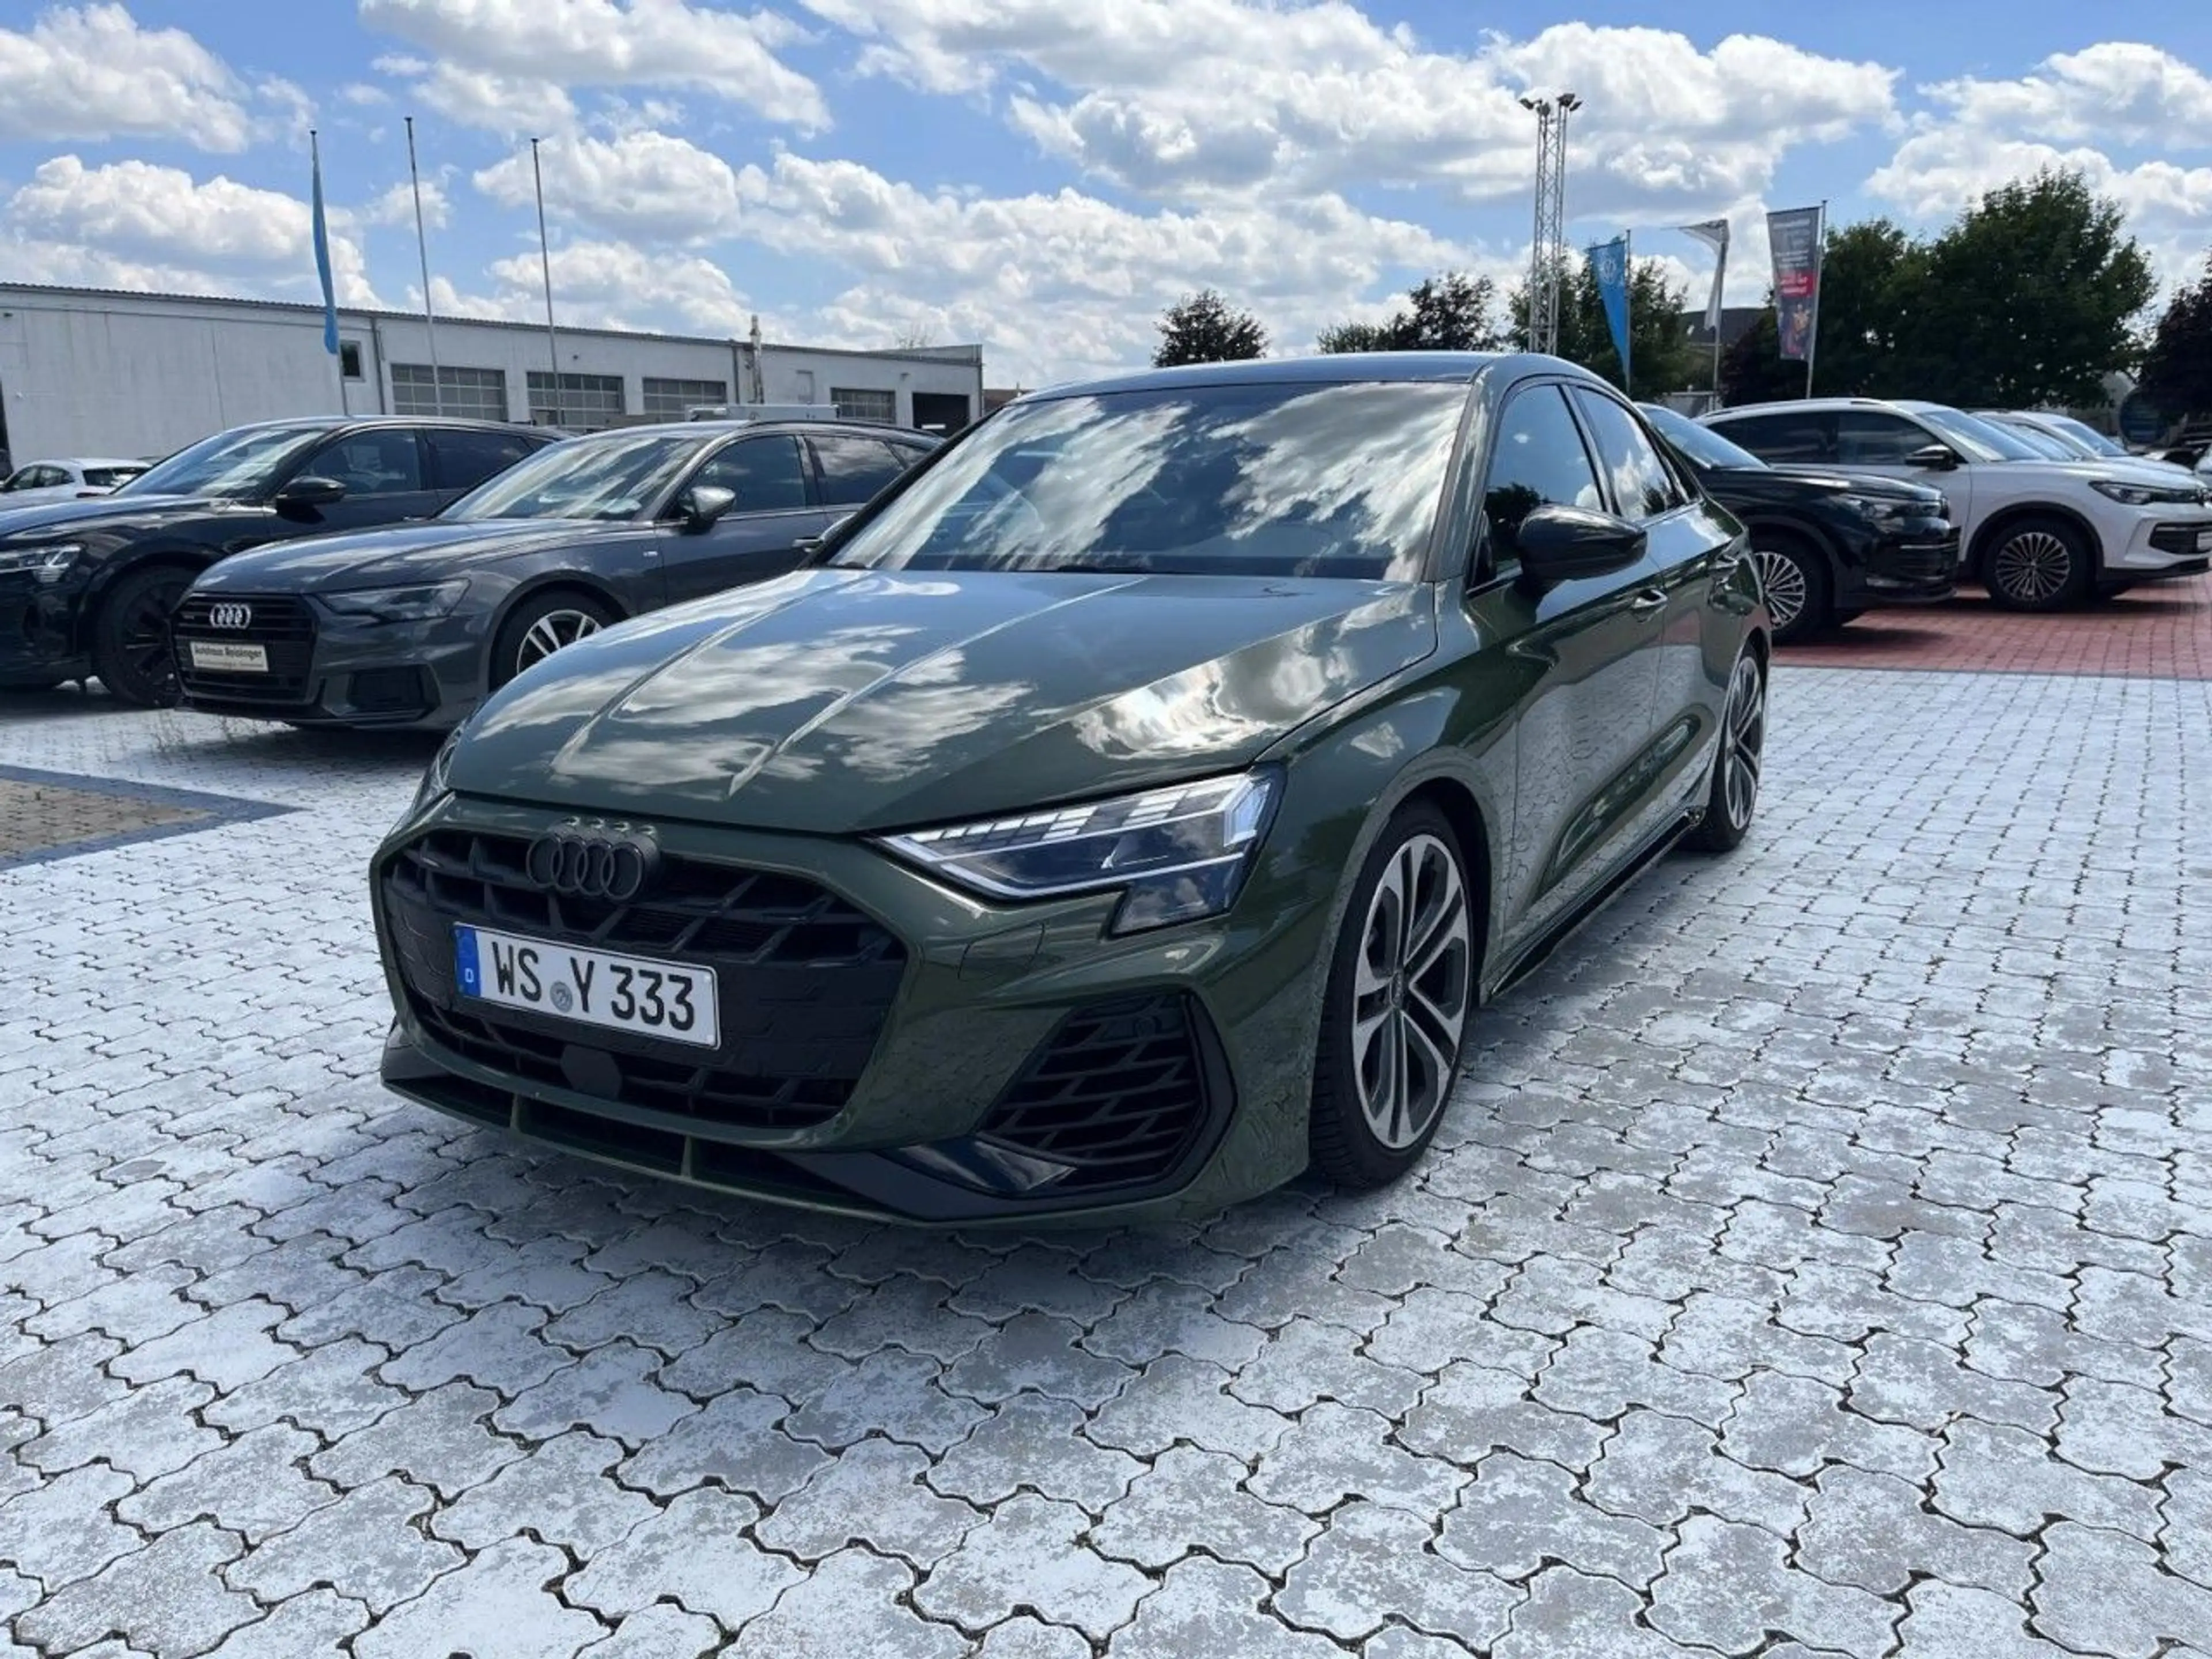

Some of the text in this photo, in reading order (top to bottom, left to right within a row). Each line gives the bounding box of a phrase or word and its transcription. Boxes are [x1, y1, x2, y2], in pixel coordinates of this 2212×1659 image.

[464, 968, 474, 983] D
[492, 941, 695, 1031] WS Y 333
